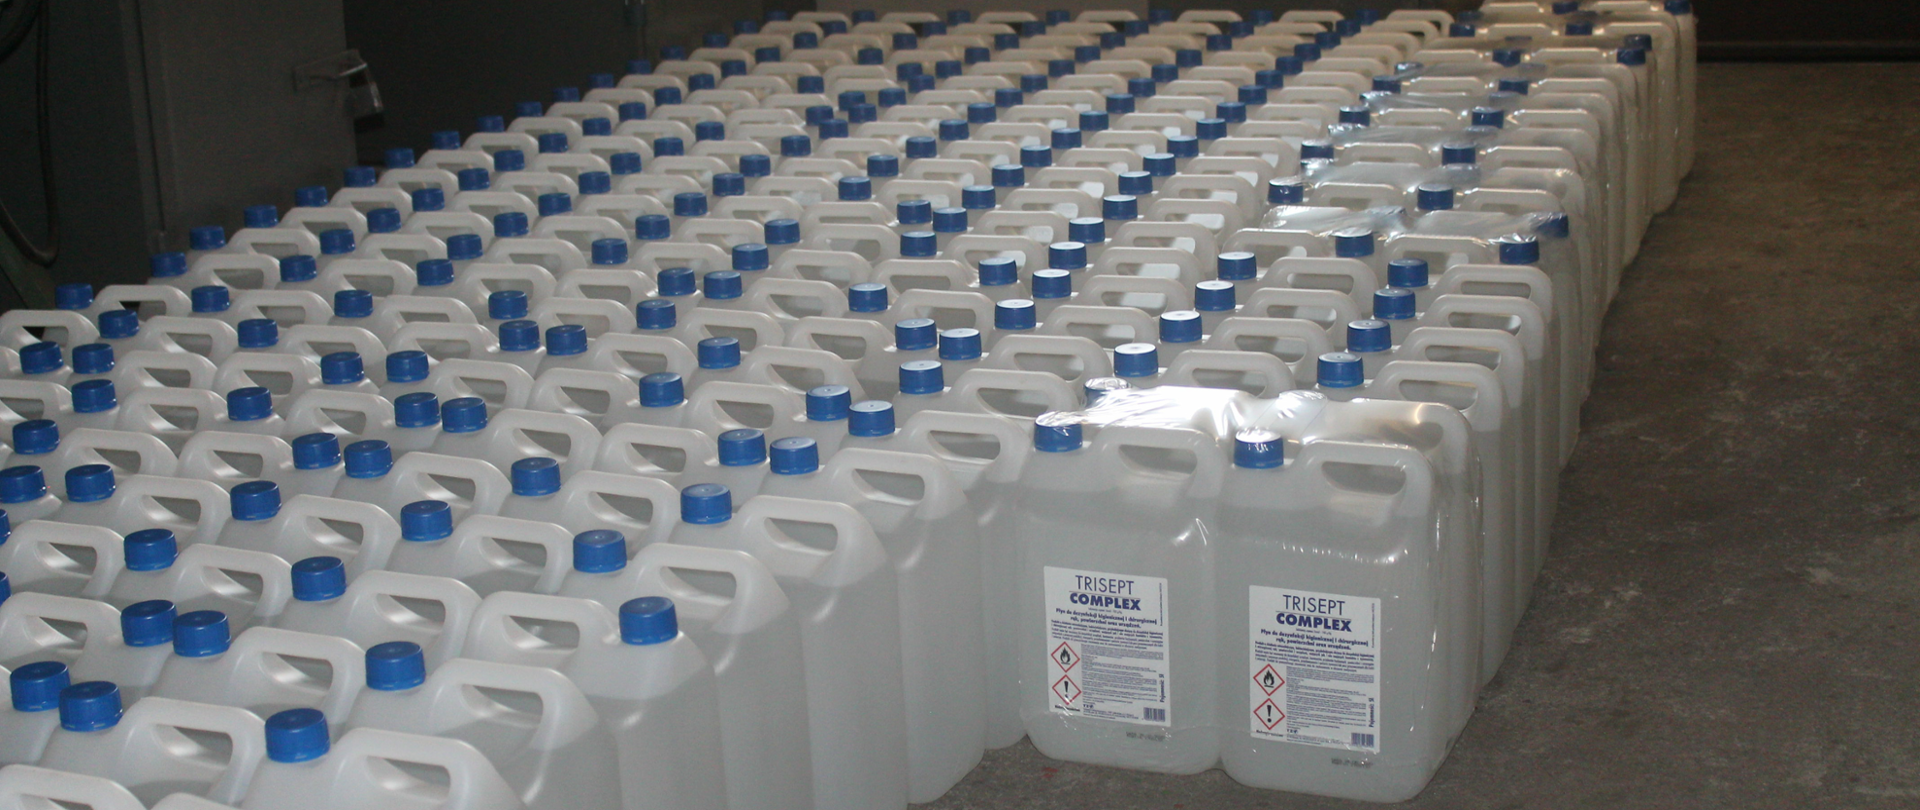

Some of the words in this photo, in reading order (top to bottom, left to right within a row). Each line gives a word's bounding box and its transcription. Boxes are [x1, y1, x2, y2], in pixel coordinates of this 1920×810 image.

[1075, 575, 1134, 594] TRISEPT
[1070, 593, 1141, 611] COMPLEX
[1283, 595, 1345, 615] TRISEPT
[1276, 613, 1352, 632] COMPLEX
